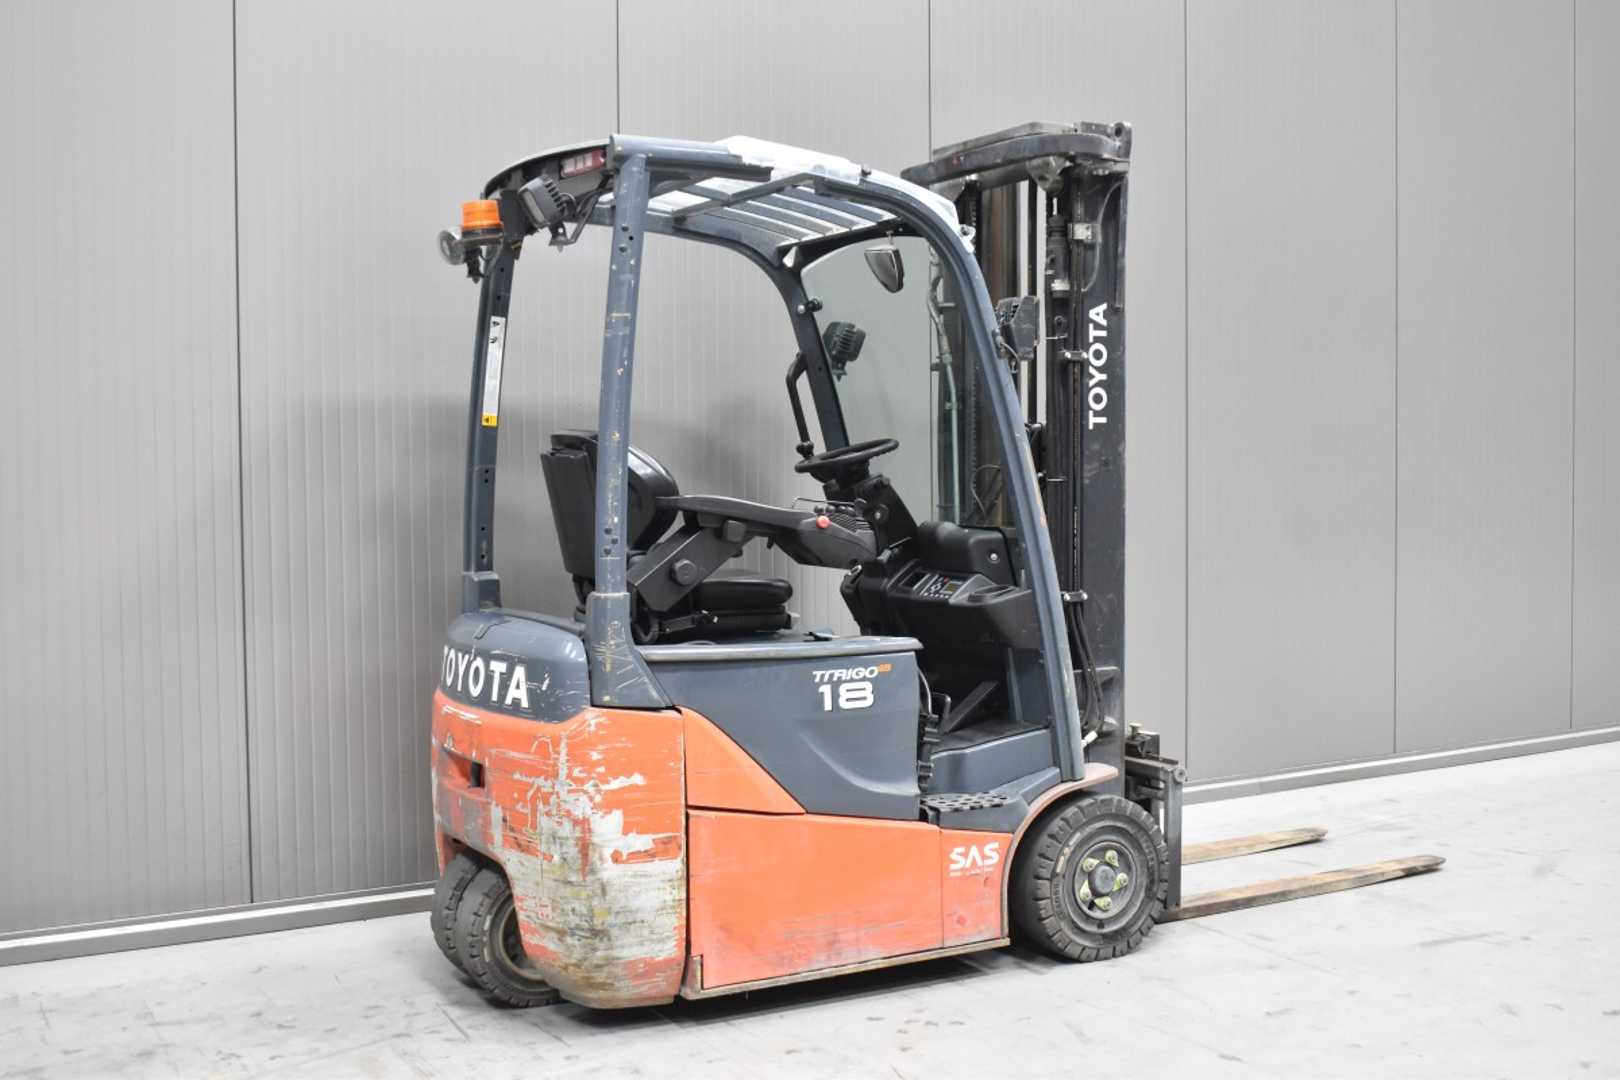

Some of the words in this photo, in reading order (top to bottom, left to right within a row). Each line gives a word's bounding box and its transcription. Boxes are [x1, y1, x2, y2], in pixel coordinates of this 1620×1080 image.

[1088, 302, 1107, 430] TOYOTA
[818, 681, 874, 711] 18
[949, 842, 999, 870] SAS
